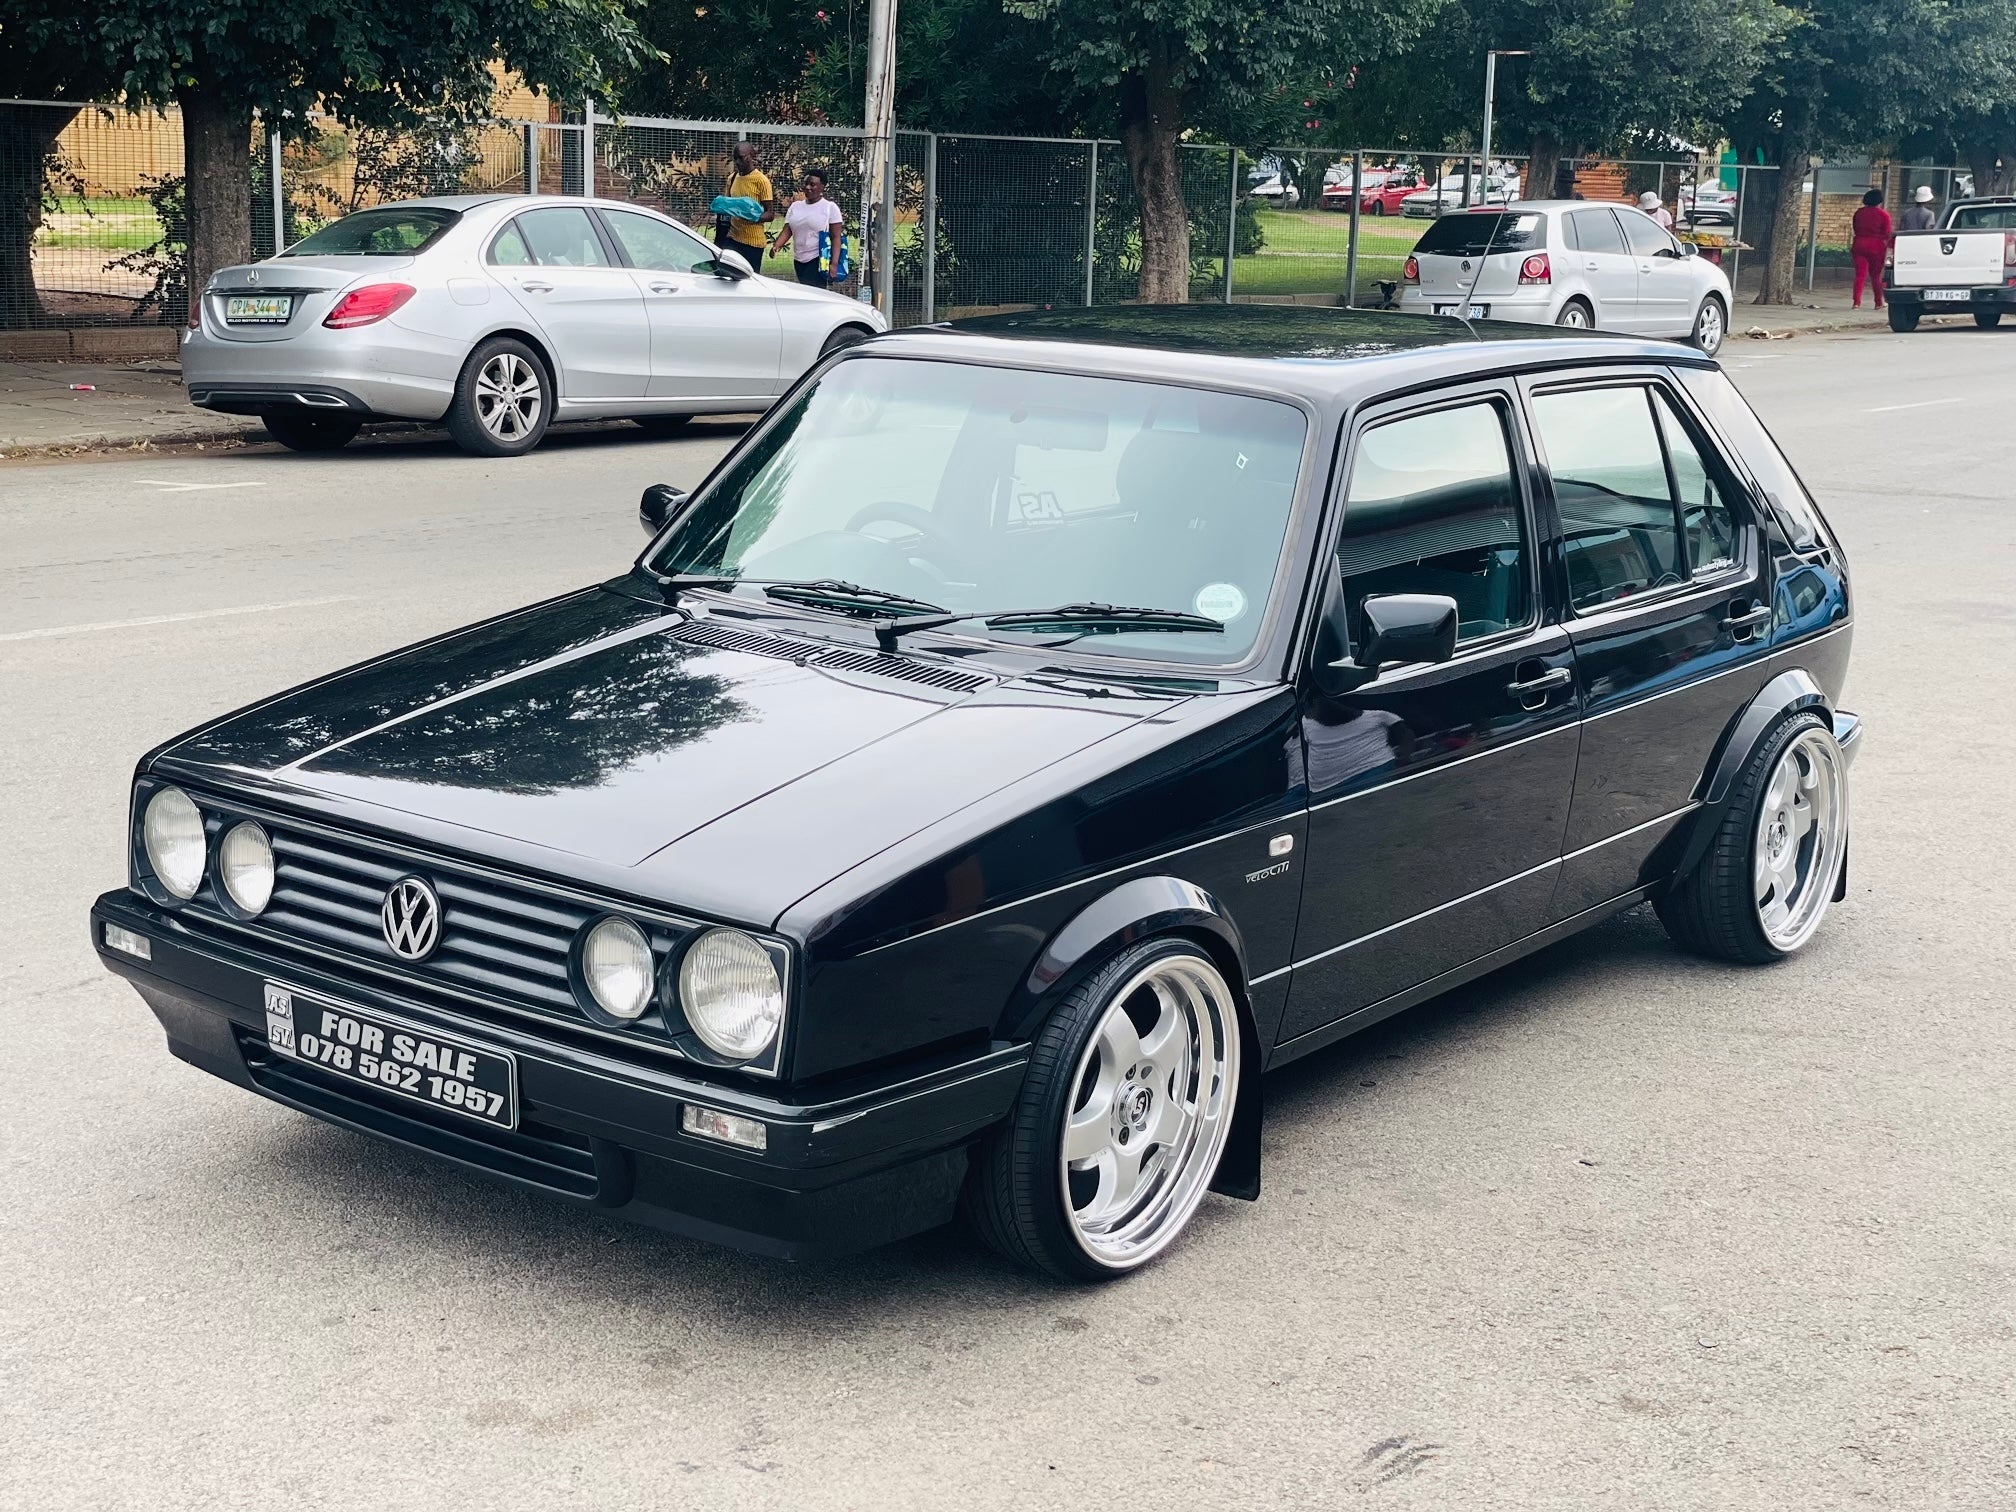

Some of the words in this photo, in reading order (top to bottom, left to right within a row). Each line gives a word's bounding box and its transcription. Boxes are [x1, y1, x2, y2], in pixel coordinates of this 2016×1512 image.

[301, 1033, 353, 1070] 078
[358, 1052, 422, 1093] 562
[428, 1076, 504, 1117] 1957
[320, 1010, 385, 1054] FOR
[391, 1034, 477, 1081] SALE
